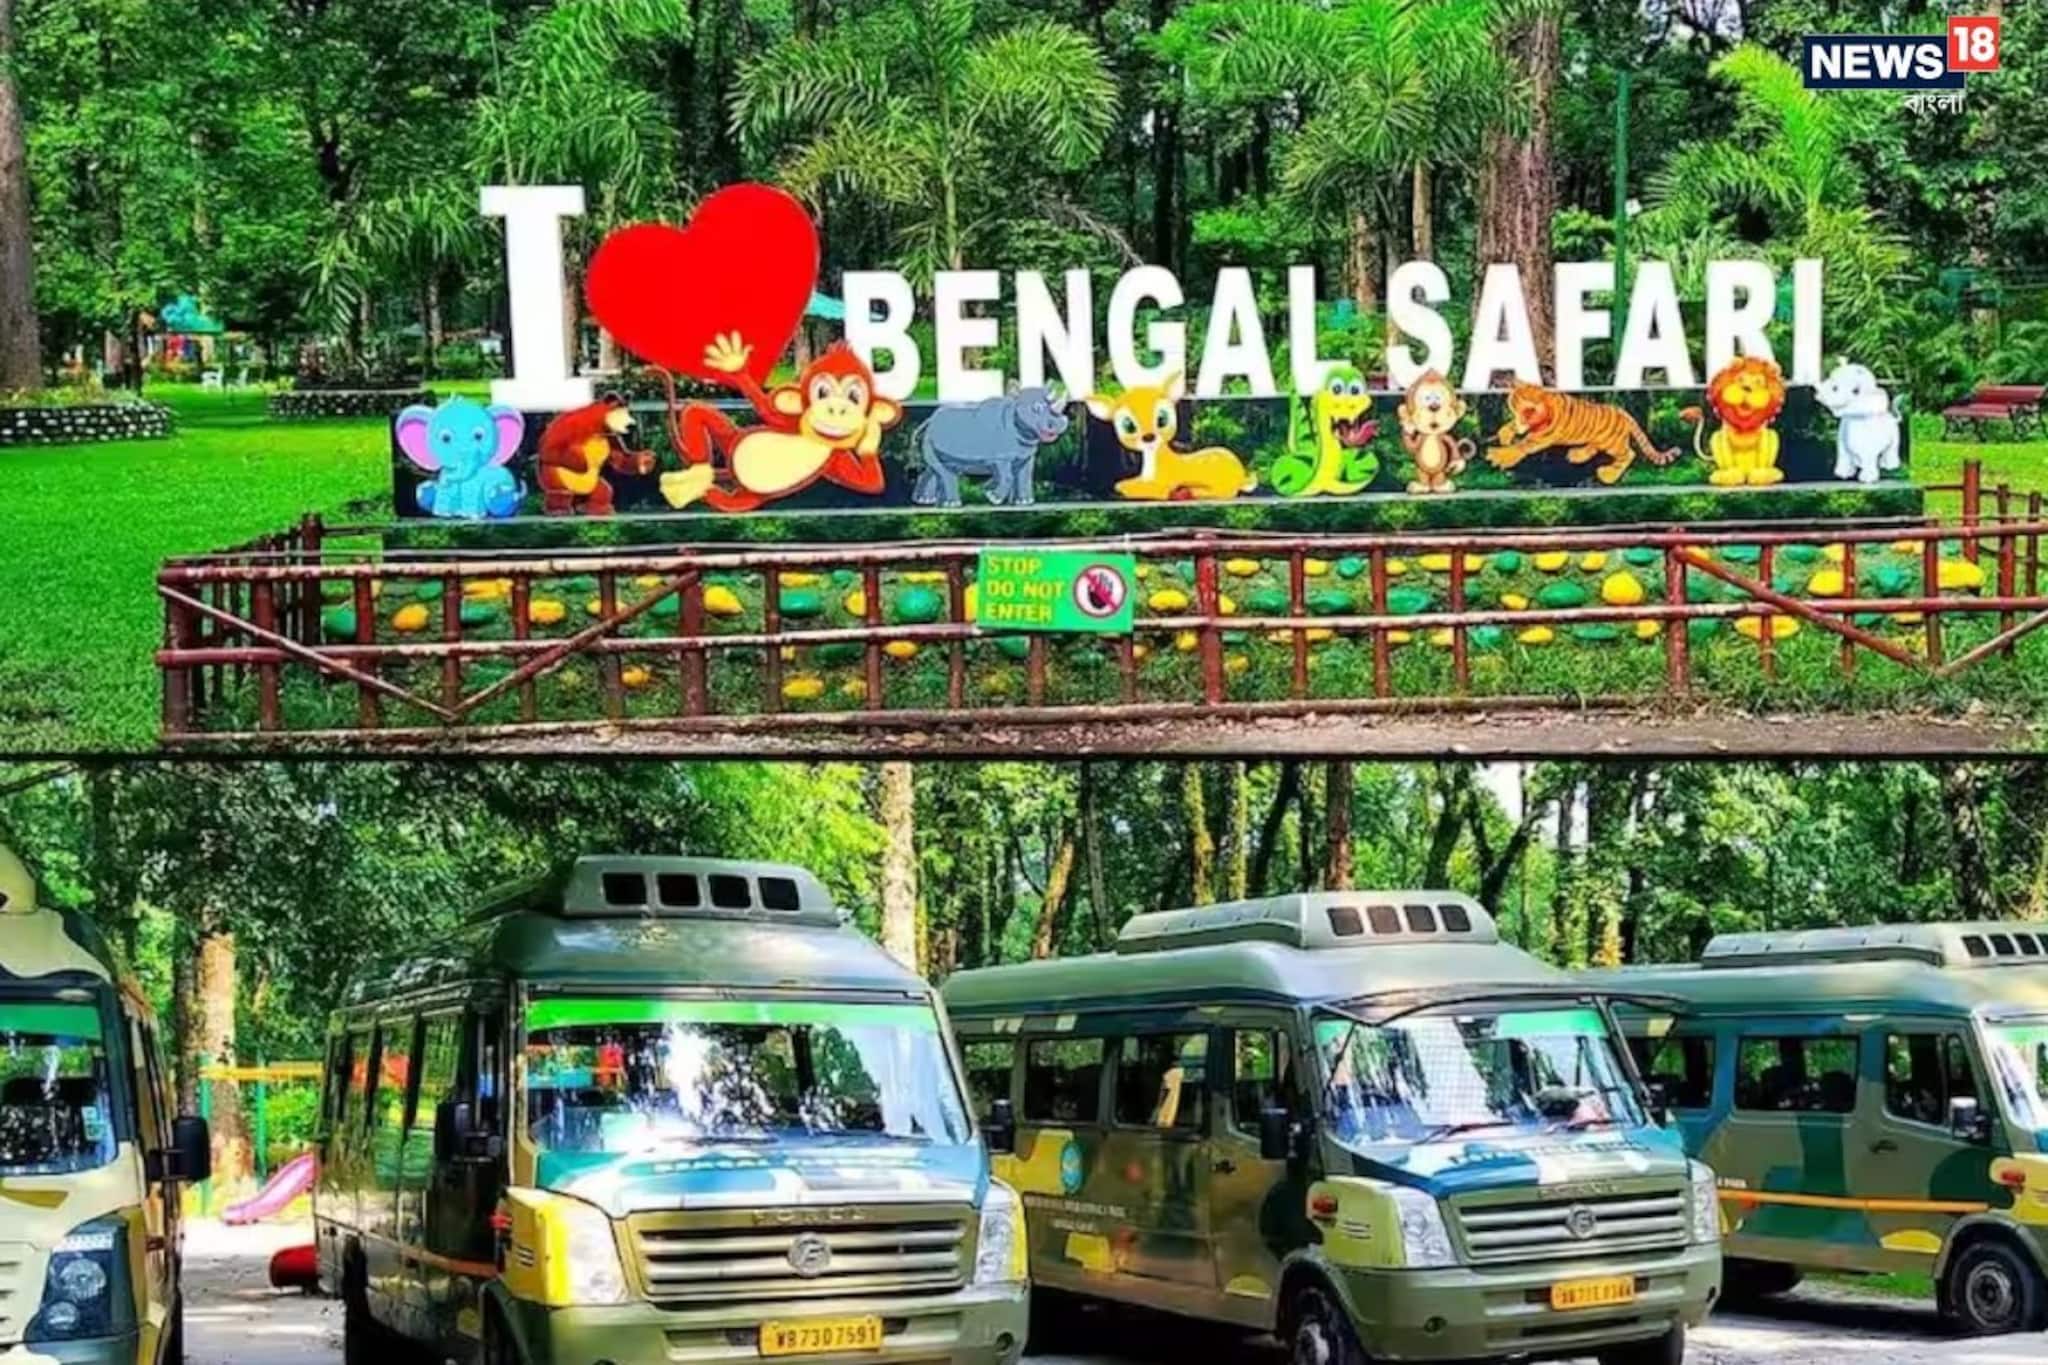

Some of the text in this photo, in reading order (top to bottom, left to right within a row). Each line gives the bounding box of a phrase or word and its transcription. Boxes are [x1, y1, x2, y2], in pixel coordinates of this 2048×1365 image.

[480, 184, 1824, 411] I BENGAL SAFARI
[986, 554, 1042, 575] STOP
[986, 579, 1065, 598] DO NOT
[986, 603, 1053, 622] ENTER
